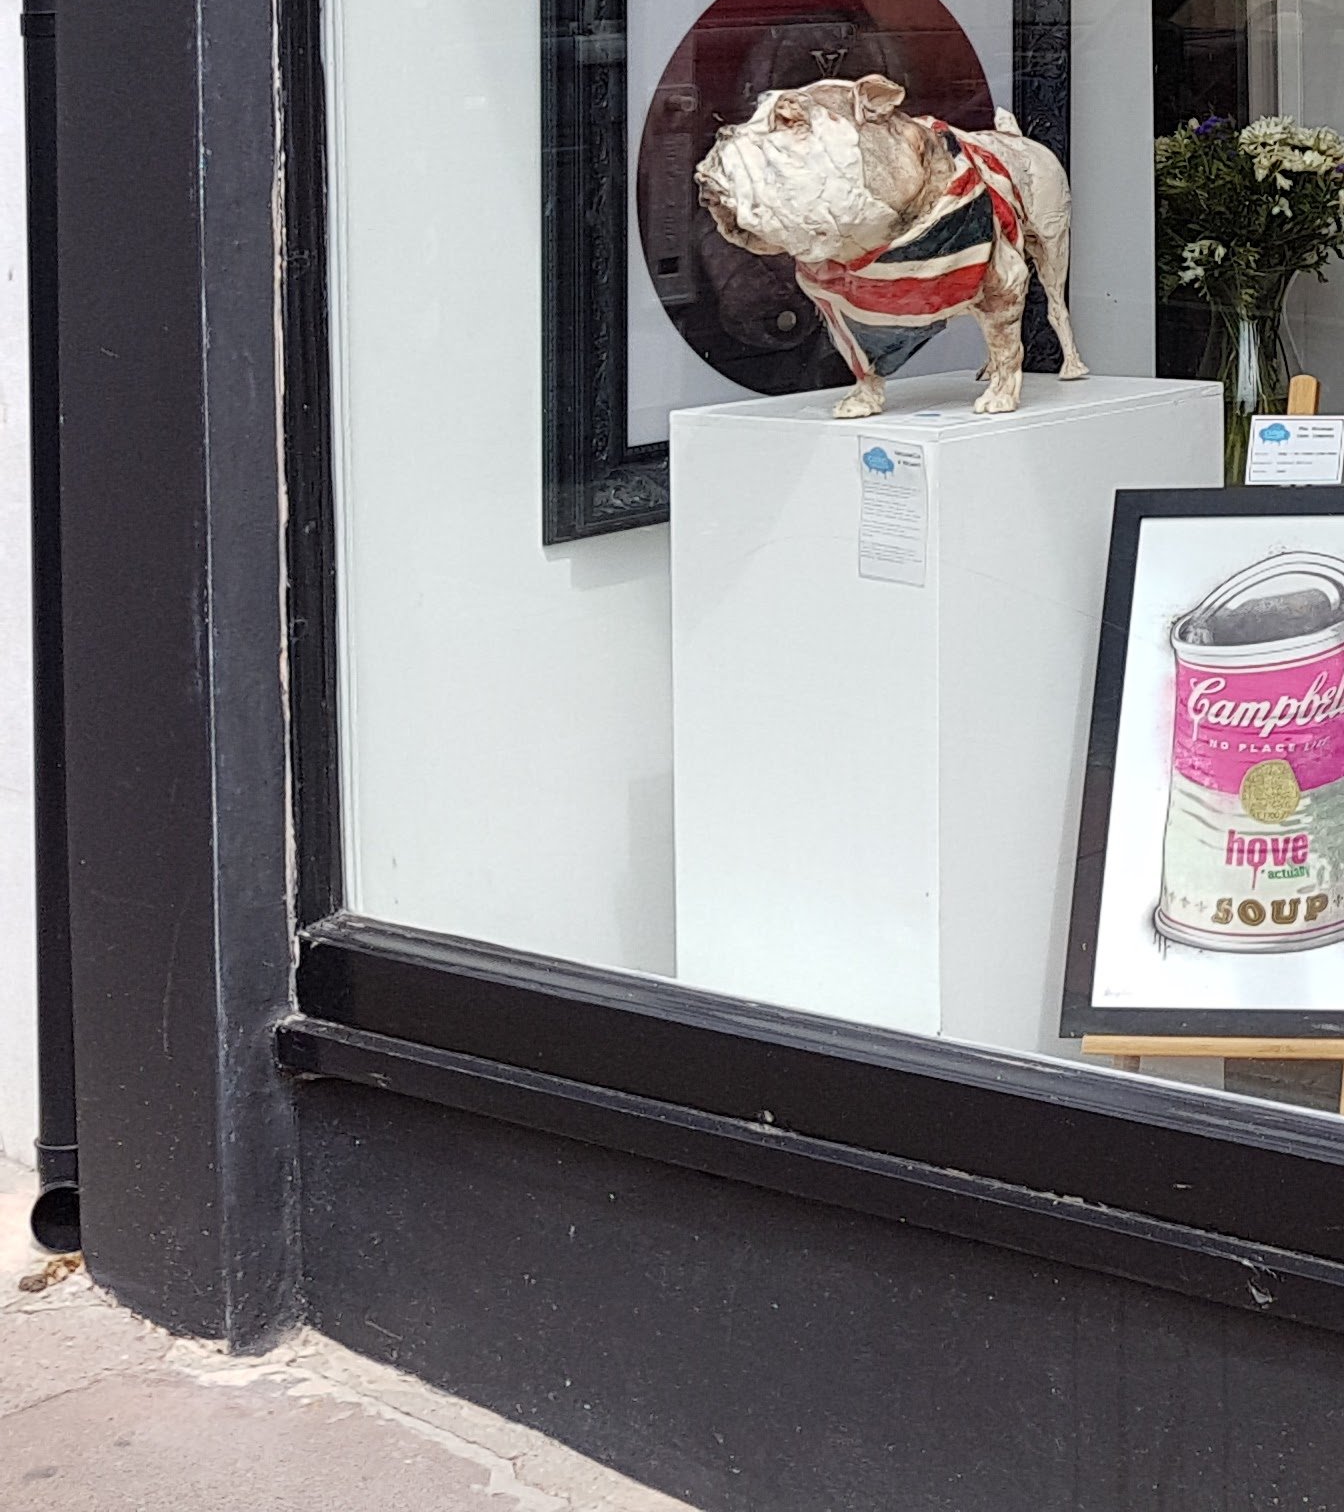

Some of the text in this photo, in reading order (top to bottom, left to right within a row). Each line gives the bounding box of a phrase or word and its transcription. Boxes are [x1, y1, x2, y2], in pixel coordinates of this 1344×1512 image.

[1208, 738, 1230, 751] NO
[1238, 742, 1296, 753] PLACE
[1211, 892, 1329, 926] SOUP
